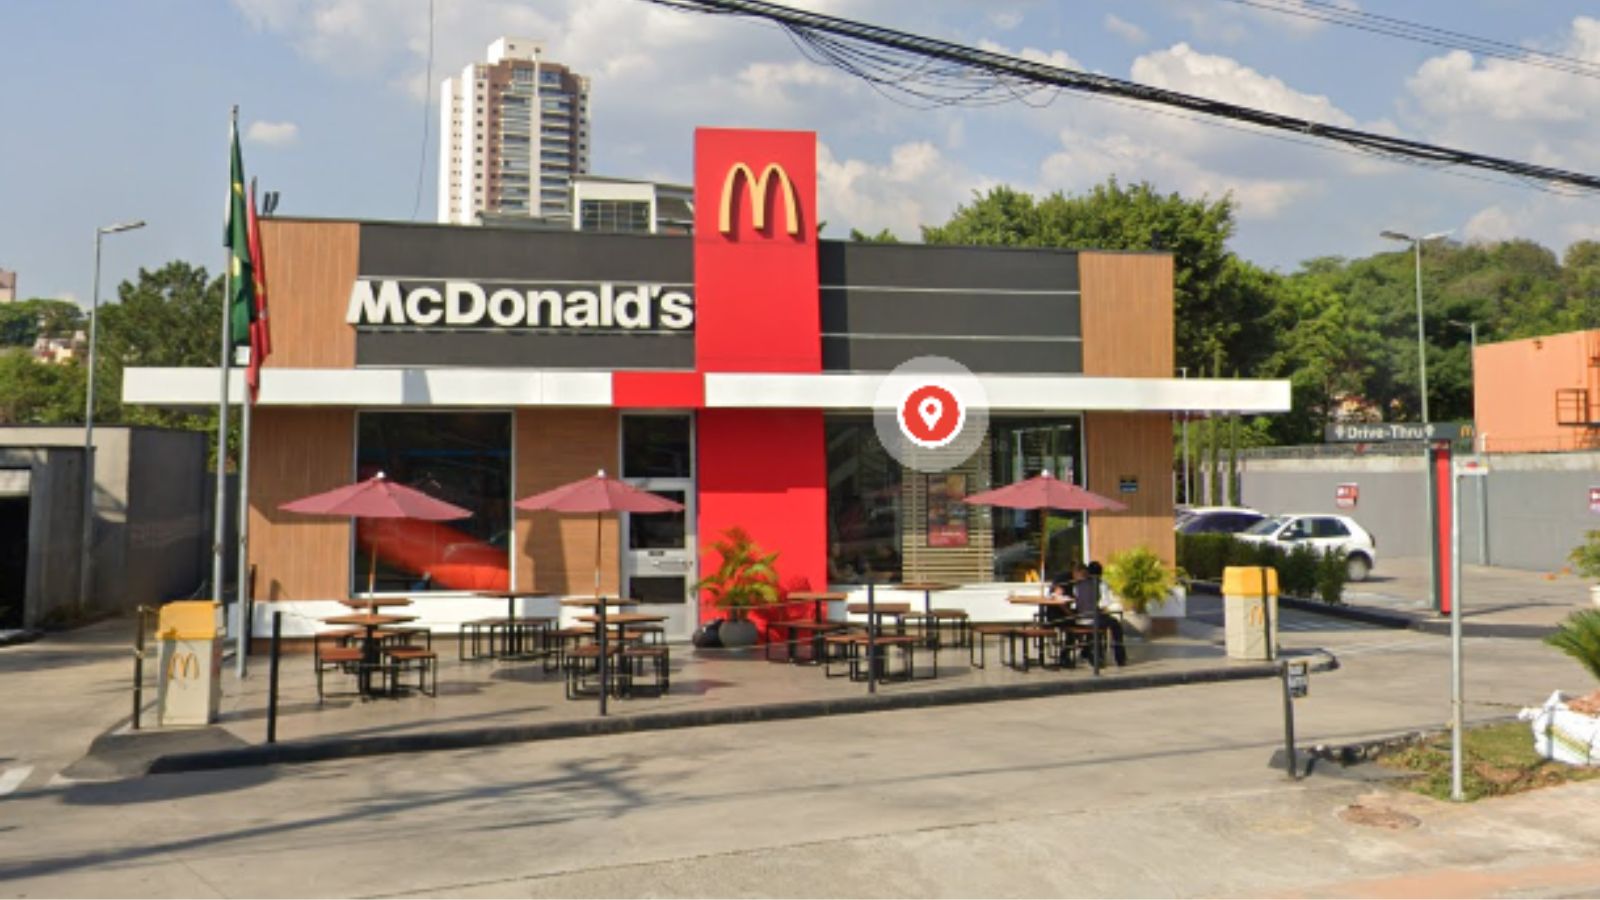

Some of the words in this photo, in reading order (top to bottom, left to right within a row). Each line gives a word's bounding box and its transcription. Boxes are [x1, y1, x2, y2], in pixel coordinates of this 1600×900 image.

[718, 162, 799, 236] M
[346, 280, 694, 328] McDonald's
[1347, 424, 1423, 440] Drive-Thru
